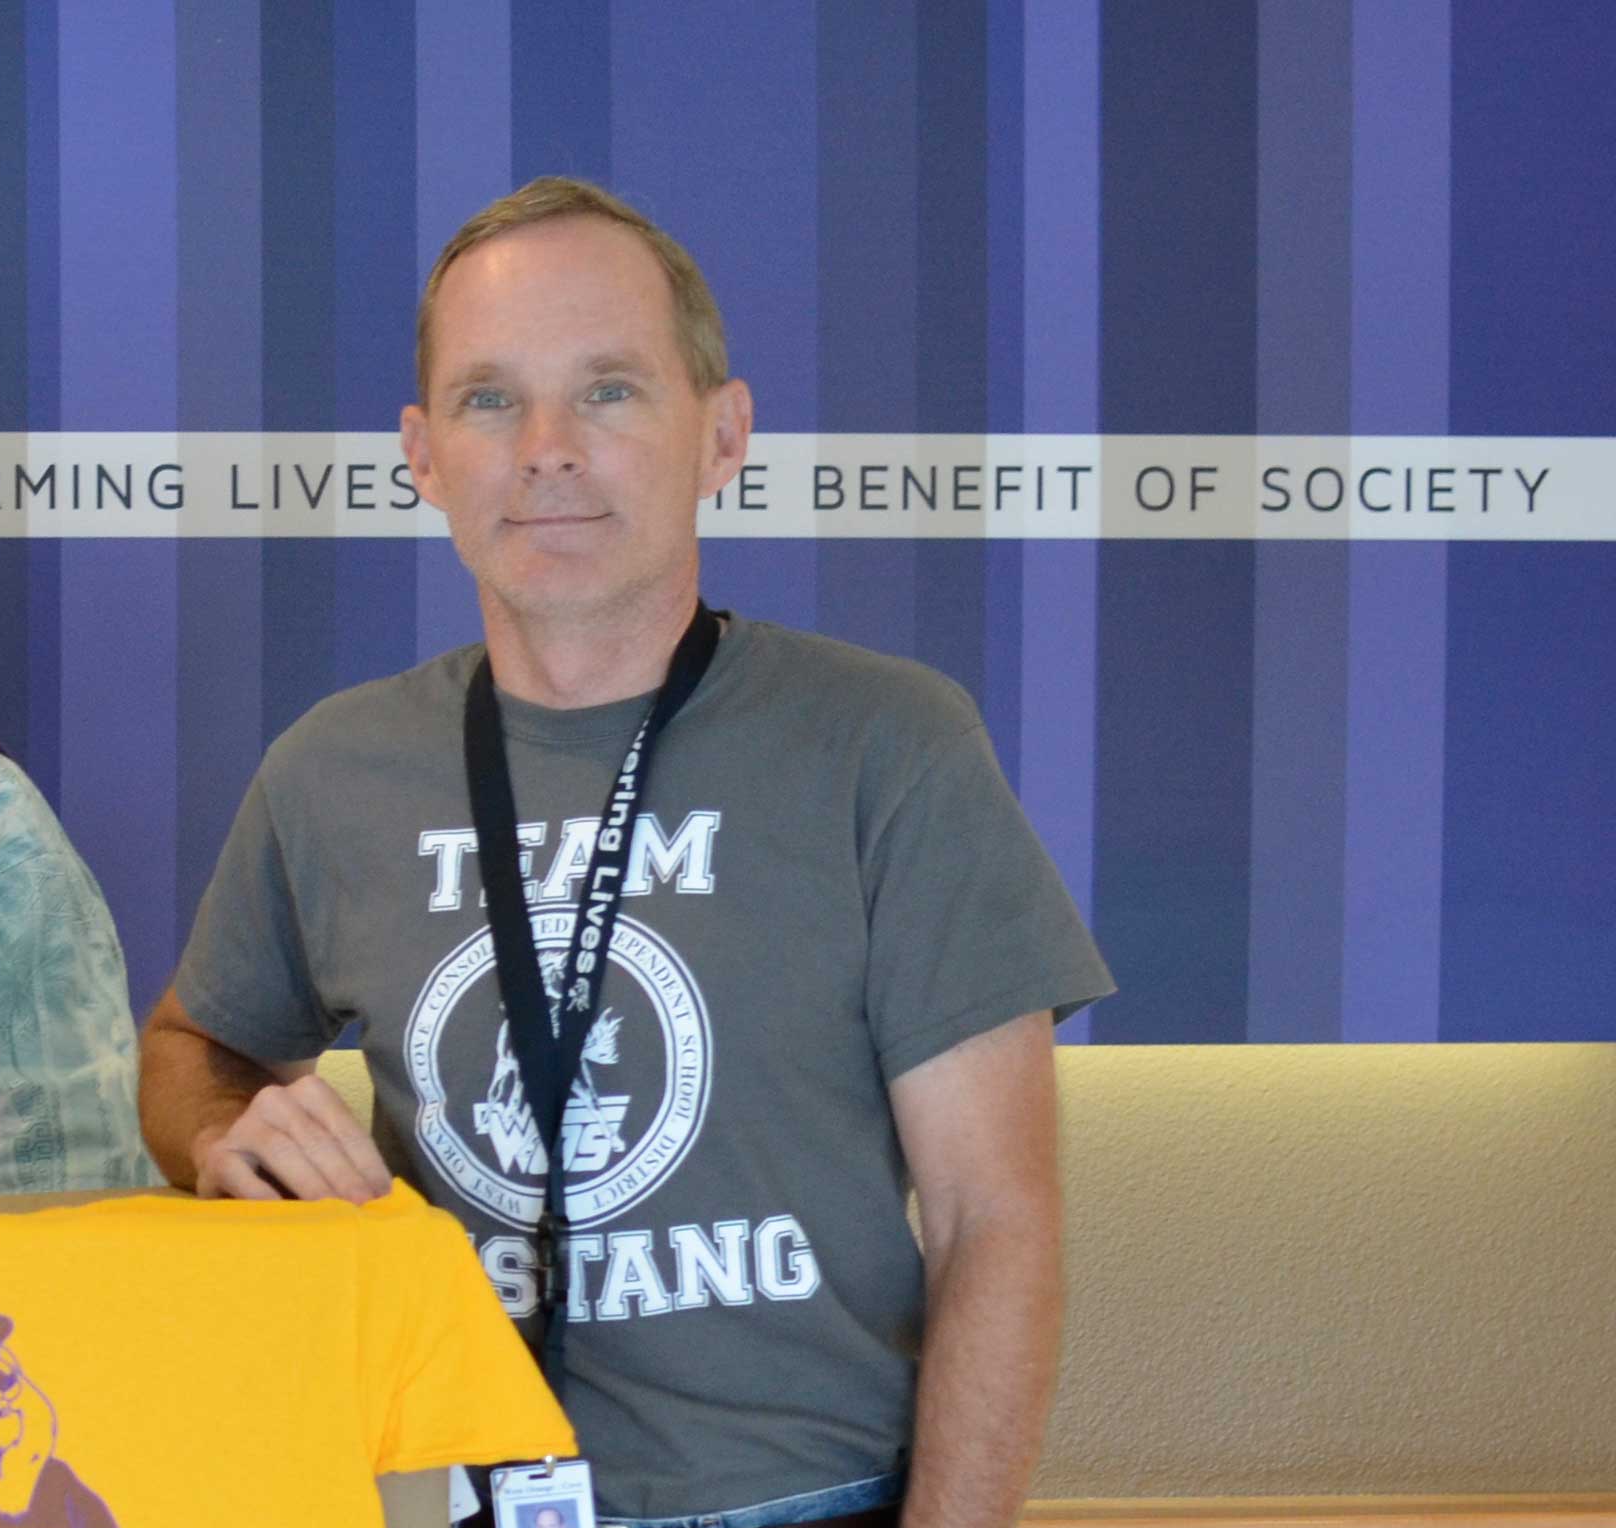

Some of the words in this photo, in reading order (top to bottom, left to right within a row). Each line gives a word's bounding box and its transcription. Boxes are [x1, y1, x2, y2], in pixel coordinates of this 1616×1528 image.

[231, 464, 423, 510] LIVES
[812, 465, 1094, 512] BENEFIT
[1135, 466, 1219, 511] OF
[1260, 466, 1551, 513] SOCIETY
[576, 867, 620, 974] Lives
[613, 931, 691, 1020] EPENDENT
[674, 1034, 697, 1119] SCHOOL
[593, 1134, 677, 1210] DISTRICT
[470, 1214, 820, 1322] STANG
